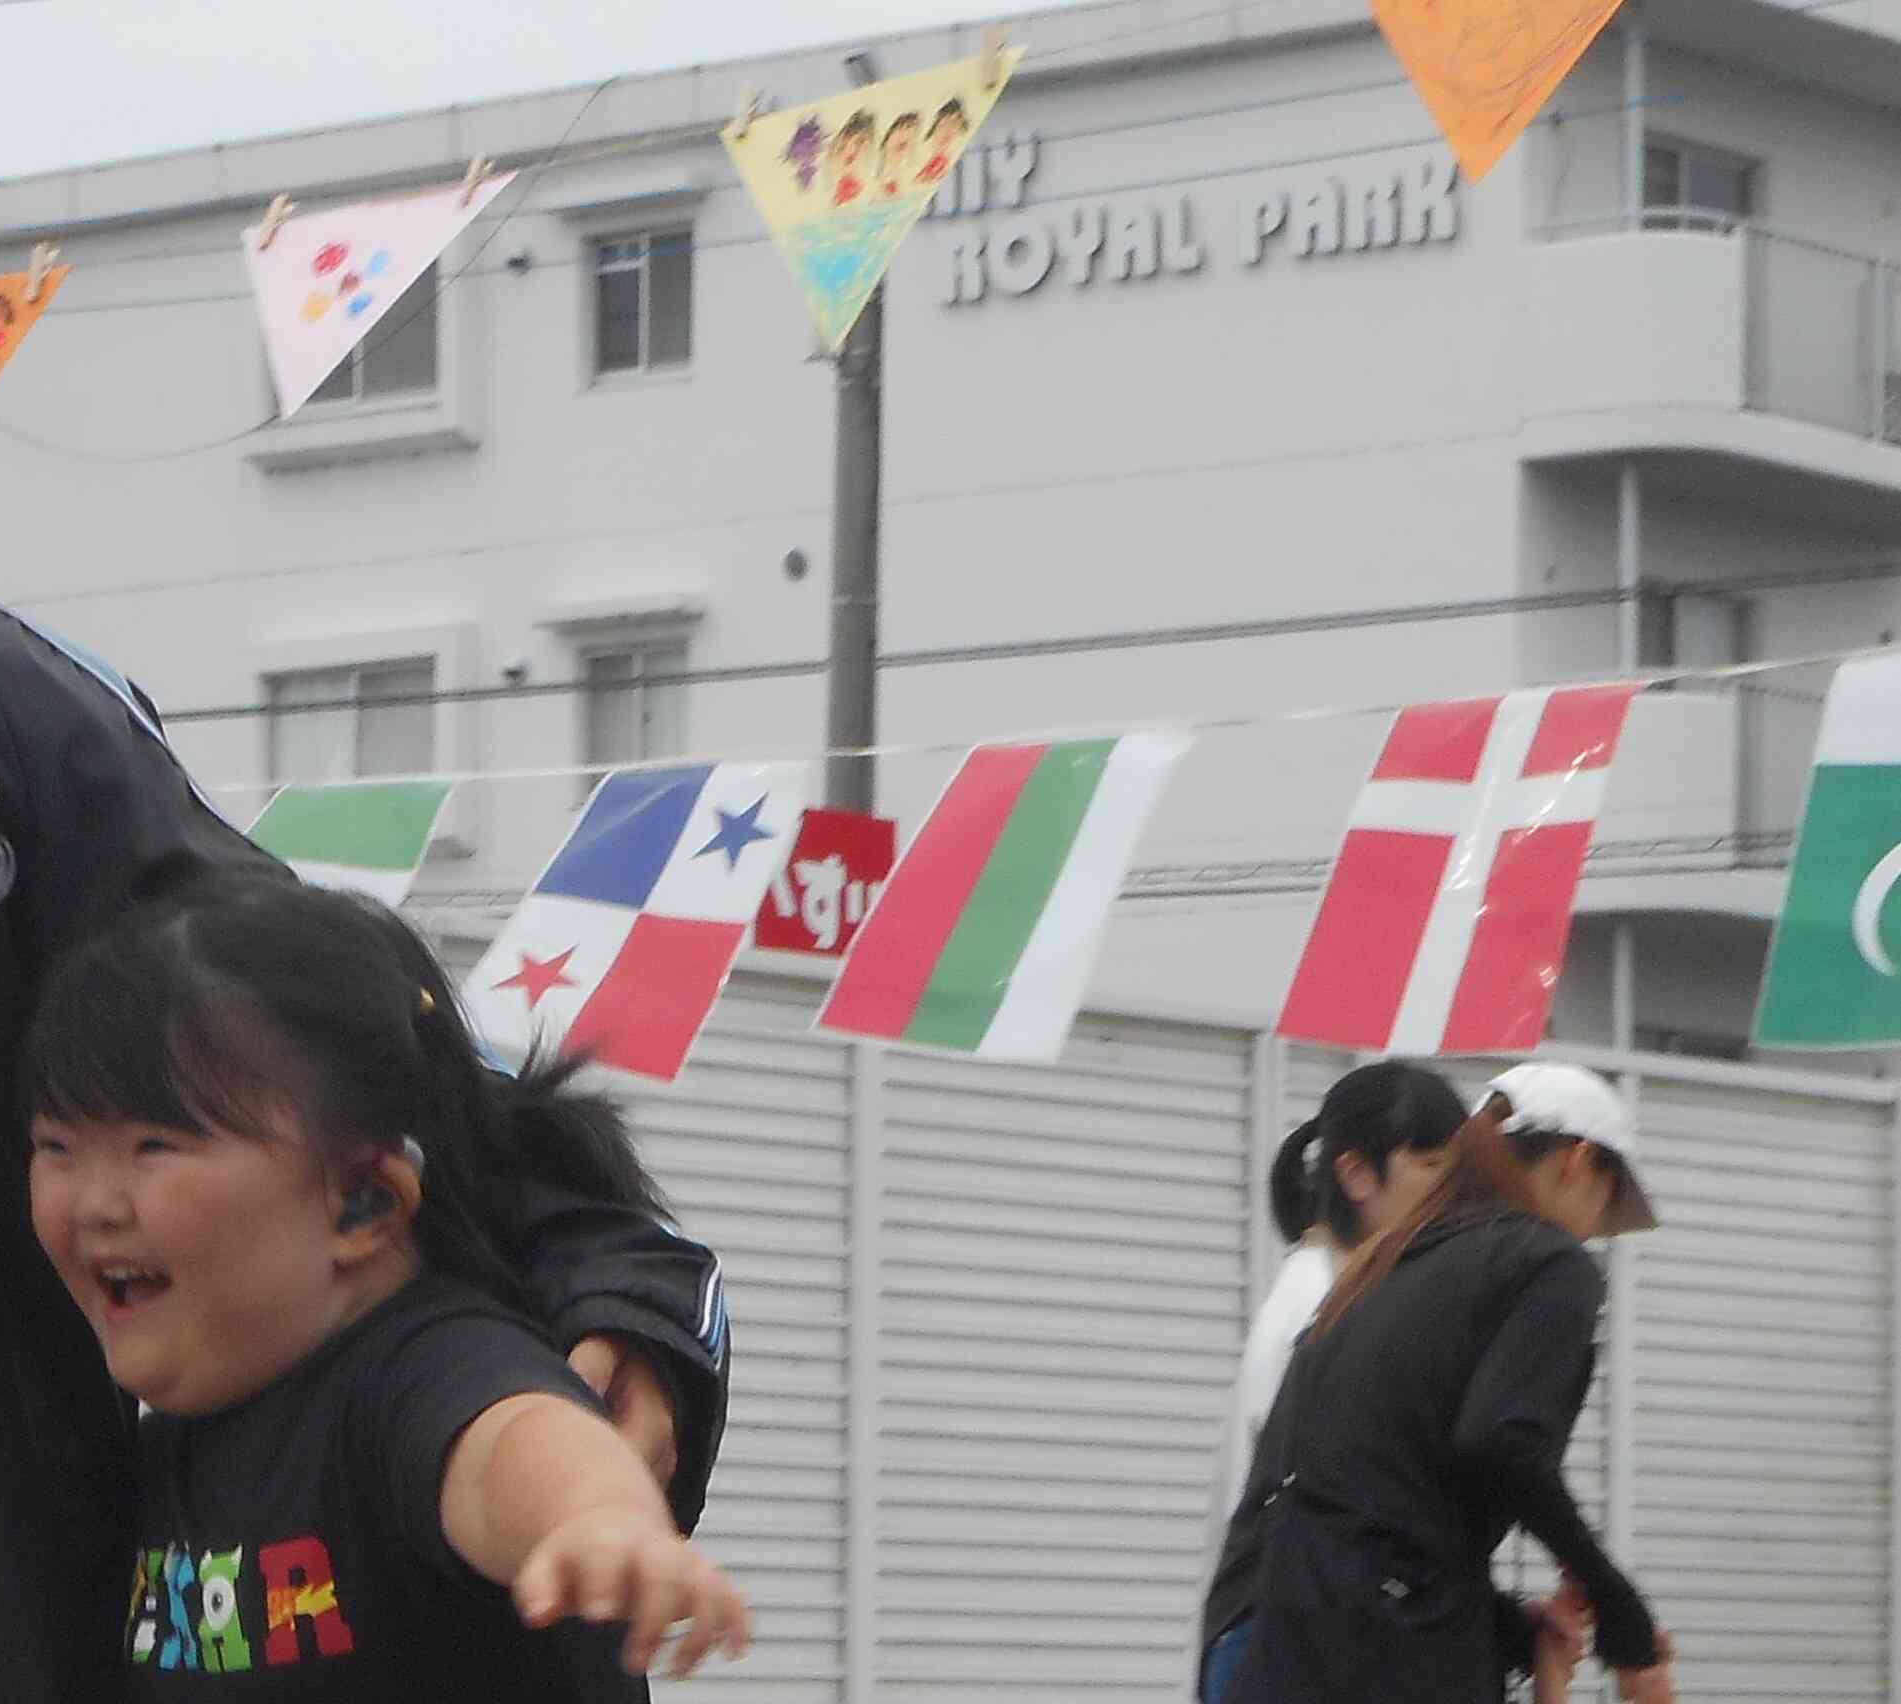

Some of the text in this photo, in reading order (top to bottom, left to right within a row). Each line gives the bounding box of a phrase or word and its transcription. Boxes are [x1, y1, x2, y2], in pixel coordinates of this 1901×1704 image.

[944, 163, 1462, 307] ROYAL PARK
[124, 1536, 355, 1673] IXAR
